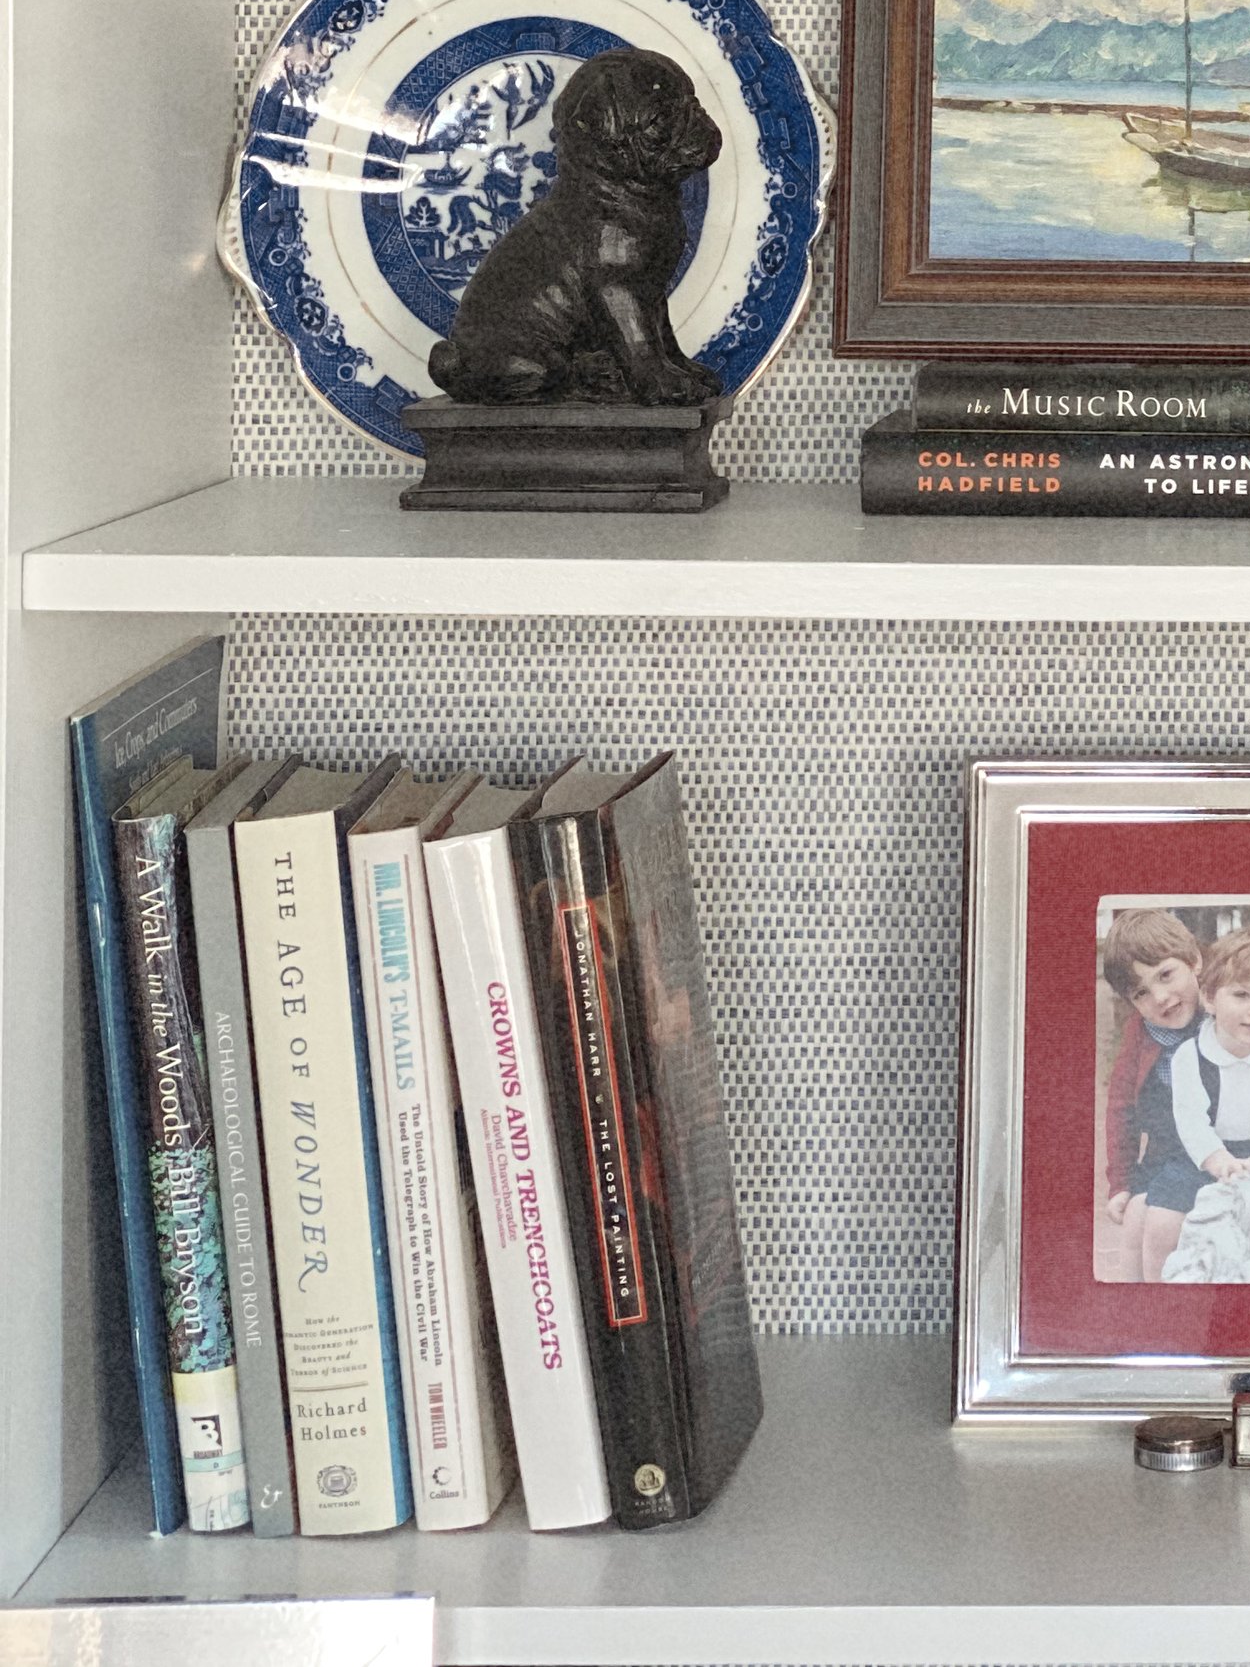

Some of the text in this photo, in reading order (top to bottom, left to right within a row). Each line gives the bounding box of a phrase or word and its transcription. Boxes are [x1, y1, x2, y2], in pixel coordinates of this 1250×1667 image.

[918, 451, 1062, 469] COL. CHRIS
[966, 401, 991, 415] the
[1099, 453, 1135, 470] AN
[917, 476, 1062, 493] HADFIELD
[1144, 478, 1178, 494] TO
[1192, 479, 1249, 495] LIFE
[136, 856, 191, 1146] A Walk in the Woods
[373, 861, 402, 896] MR.
[389, 989, 416, 1091] T-MAILS
[275, 851, 328, 1293] THE AGE OF WONDER
[487, 981, 522, 1098] CROWNS
[506, 1105, 531, 1162] AND
[574, 932, 629, 1298] JONATHAN HARR THE LOST PAINTING
[215, 1011, 263, 1349] ARCHAEOLOGICAL GUIDE TO ROME
[411, 1103, 443, 1366] The Untold Story of How Abraham Lincoln
[168, 1166, 203, 1334] Bill Bryson
[516, 1168, 563, 1371] TRENCHCOATS
[297, 1398, 368, 1419] Richard
[301, 1425, 367, 1441] Holmes
